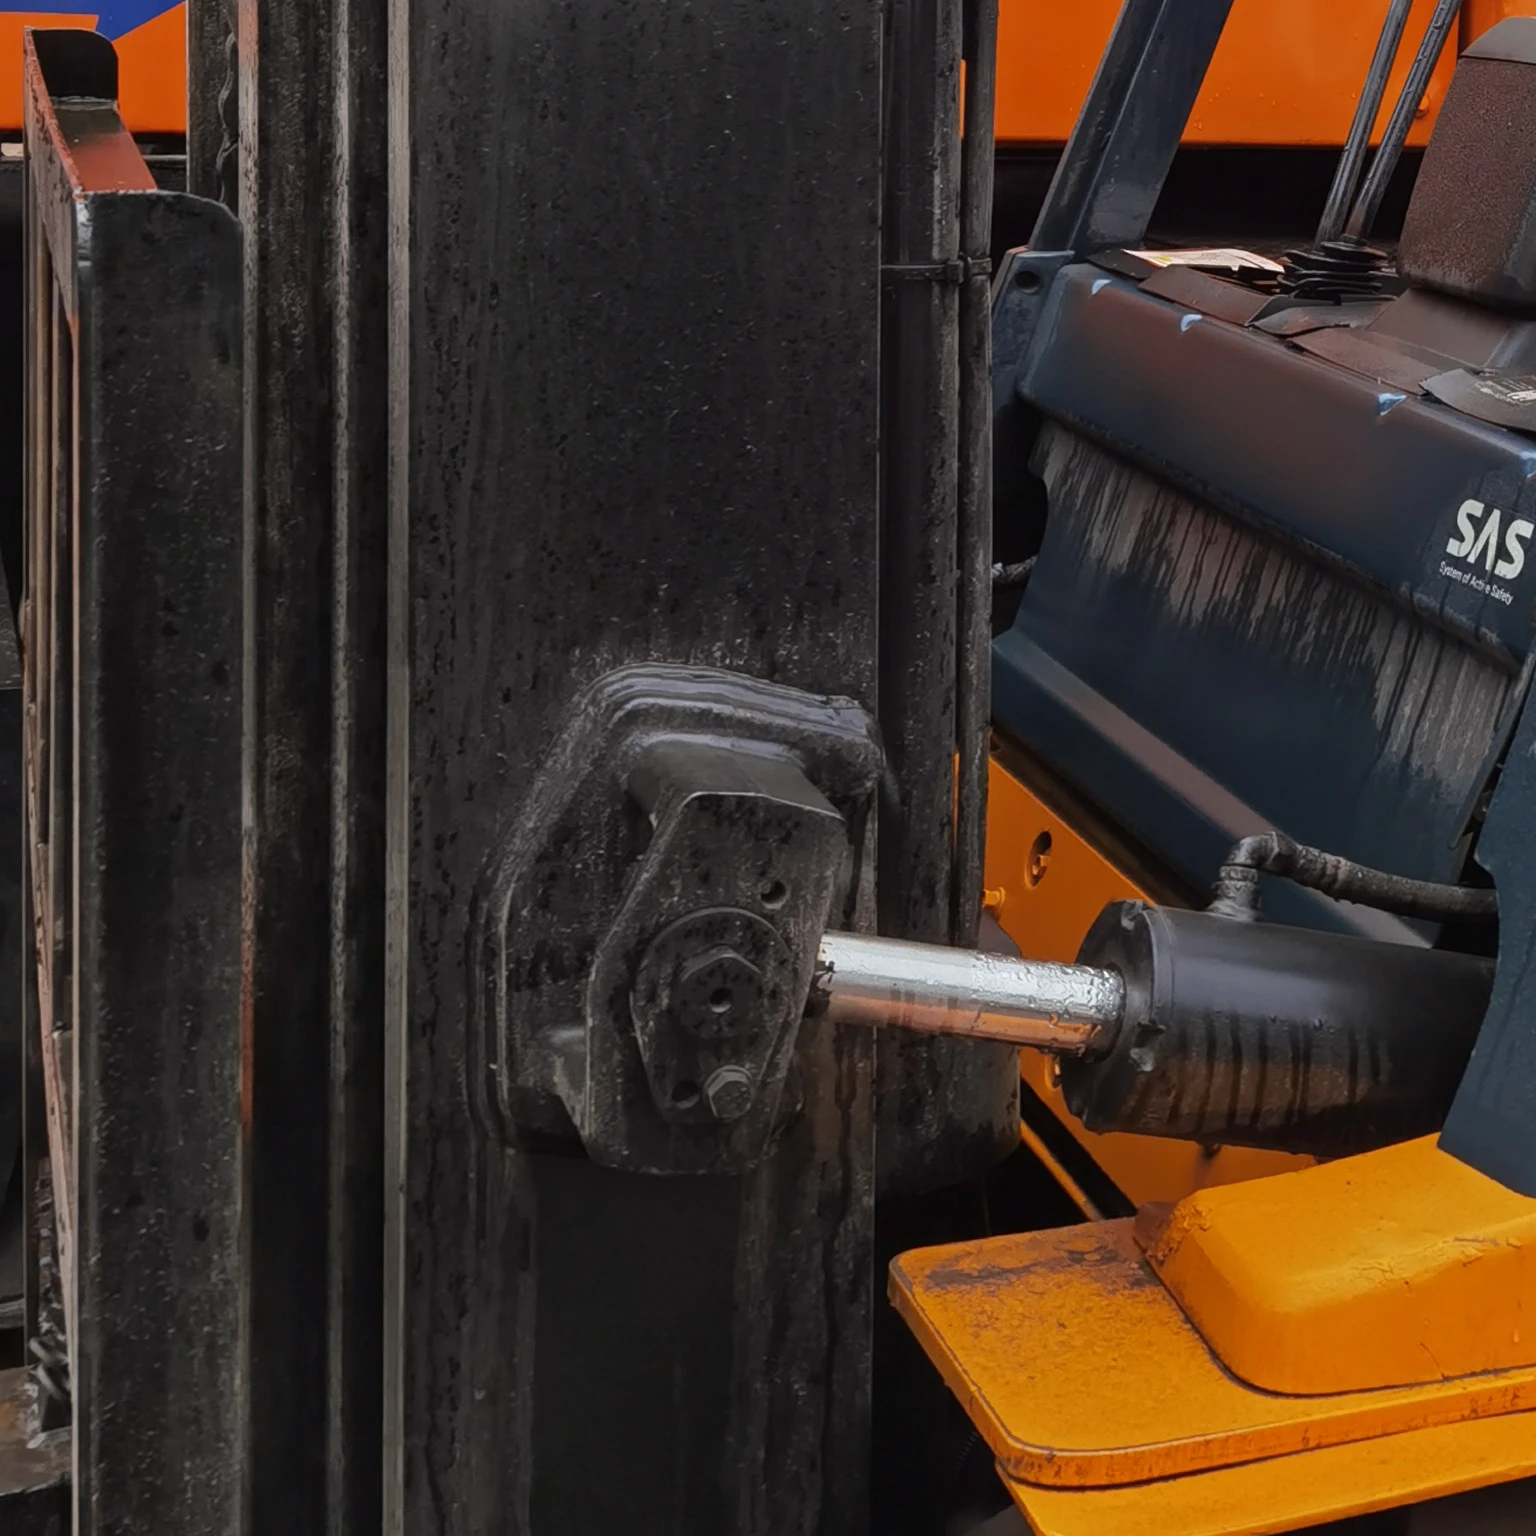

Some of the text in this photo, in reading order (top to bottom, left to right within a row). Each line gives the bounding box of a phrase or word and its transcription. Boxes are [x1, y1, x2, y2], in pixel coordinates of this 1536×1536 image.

[1446, 498, 1535, 580] SAS
[1439, 561, 1514, 606] System of Actie Safety
